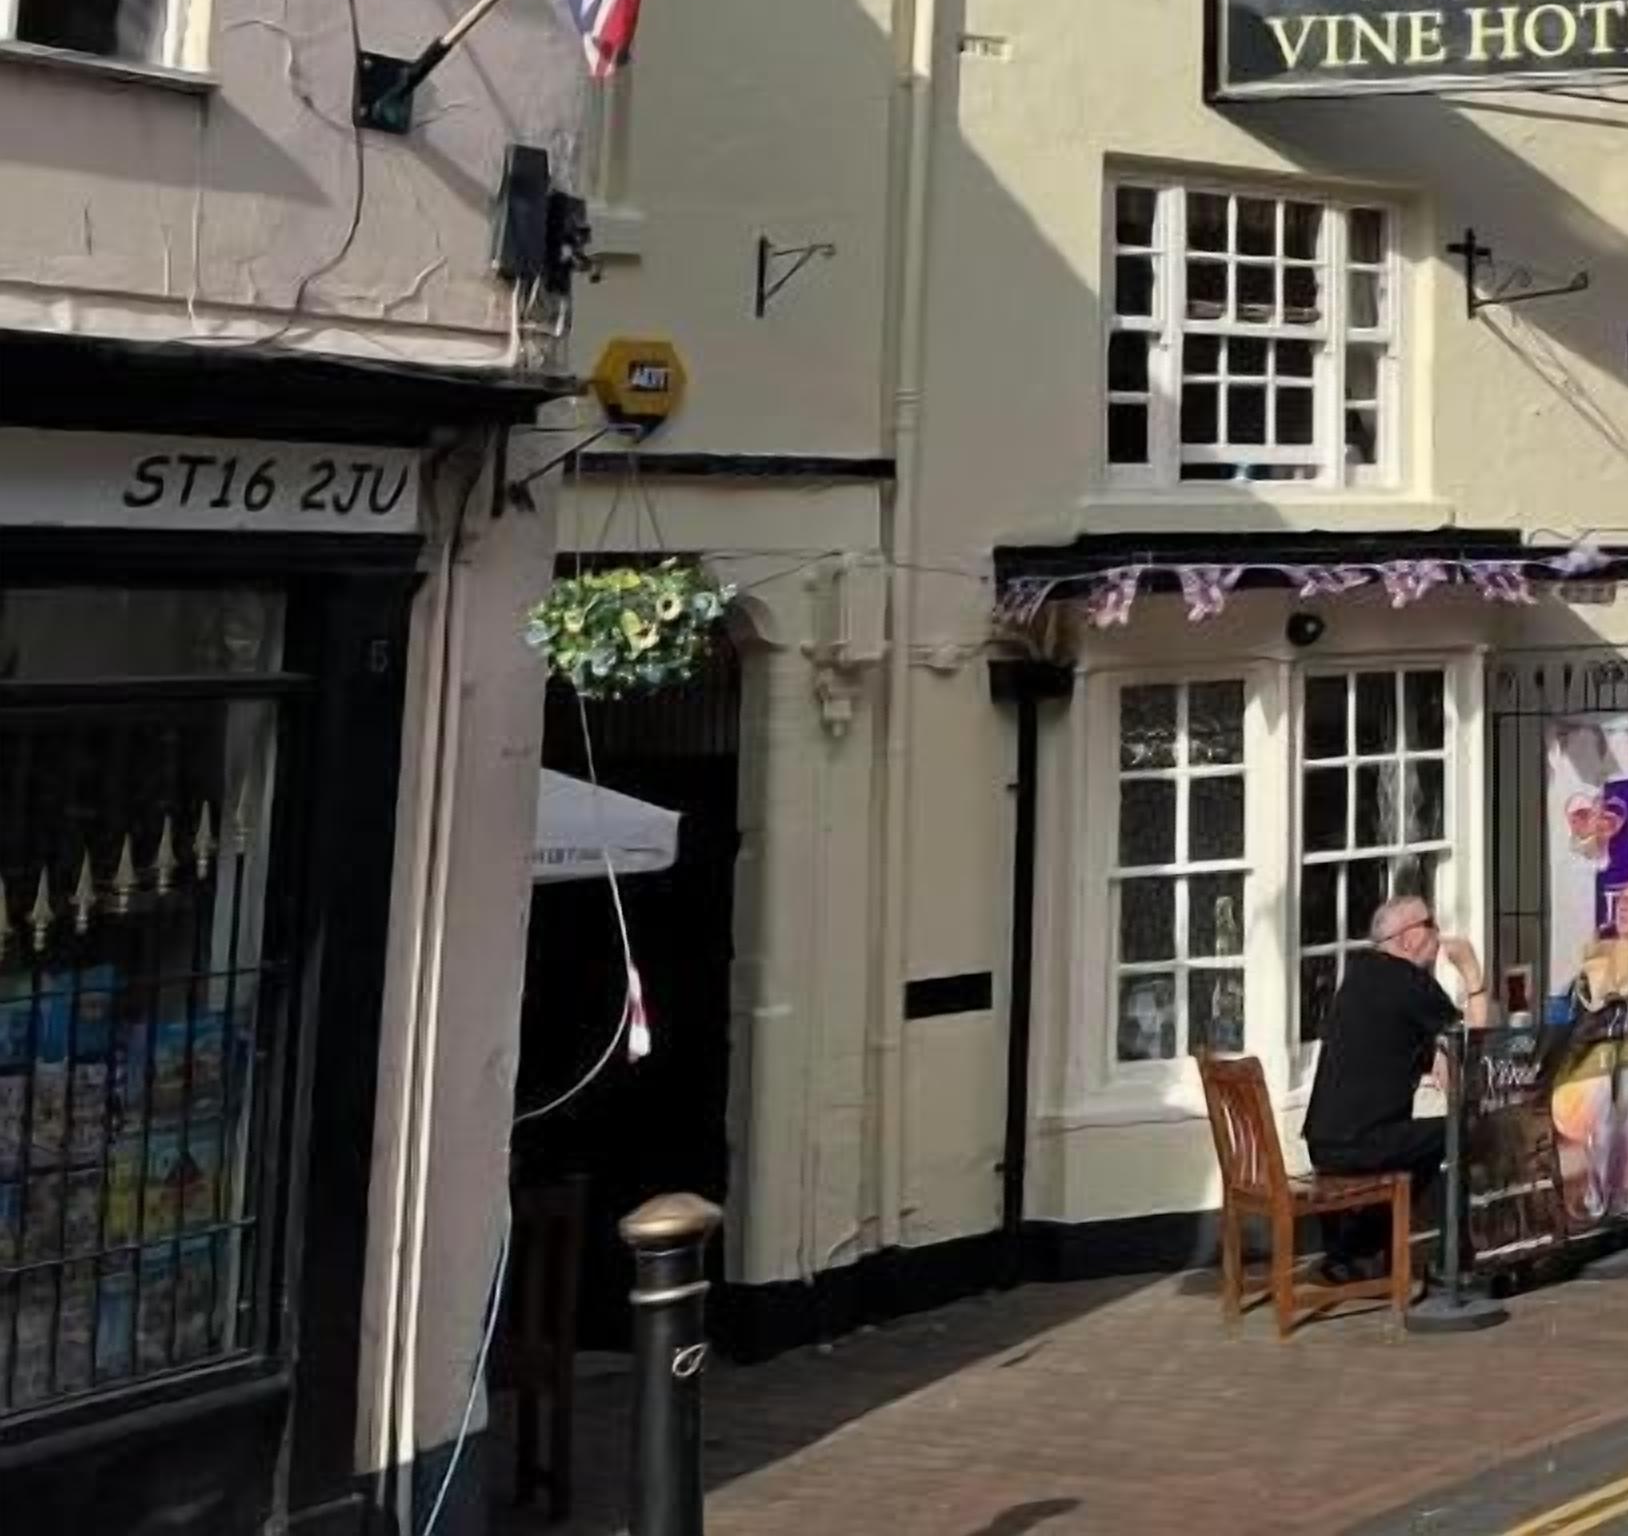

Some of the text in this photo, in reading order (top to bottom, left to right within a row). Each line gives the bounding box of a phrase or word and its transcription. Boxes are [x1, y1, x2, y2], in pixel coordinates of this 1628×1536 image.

[1264, 9, 1448, 69] VINE
[123, 454, 409, 514] ST16 2JU
